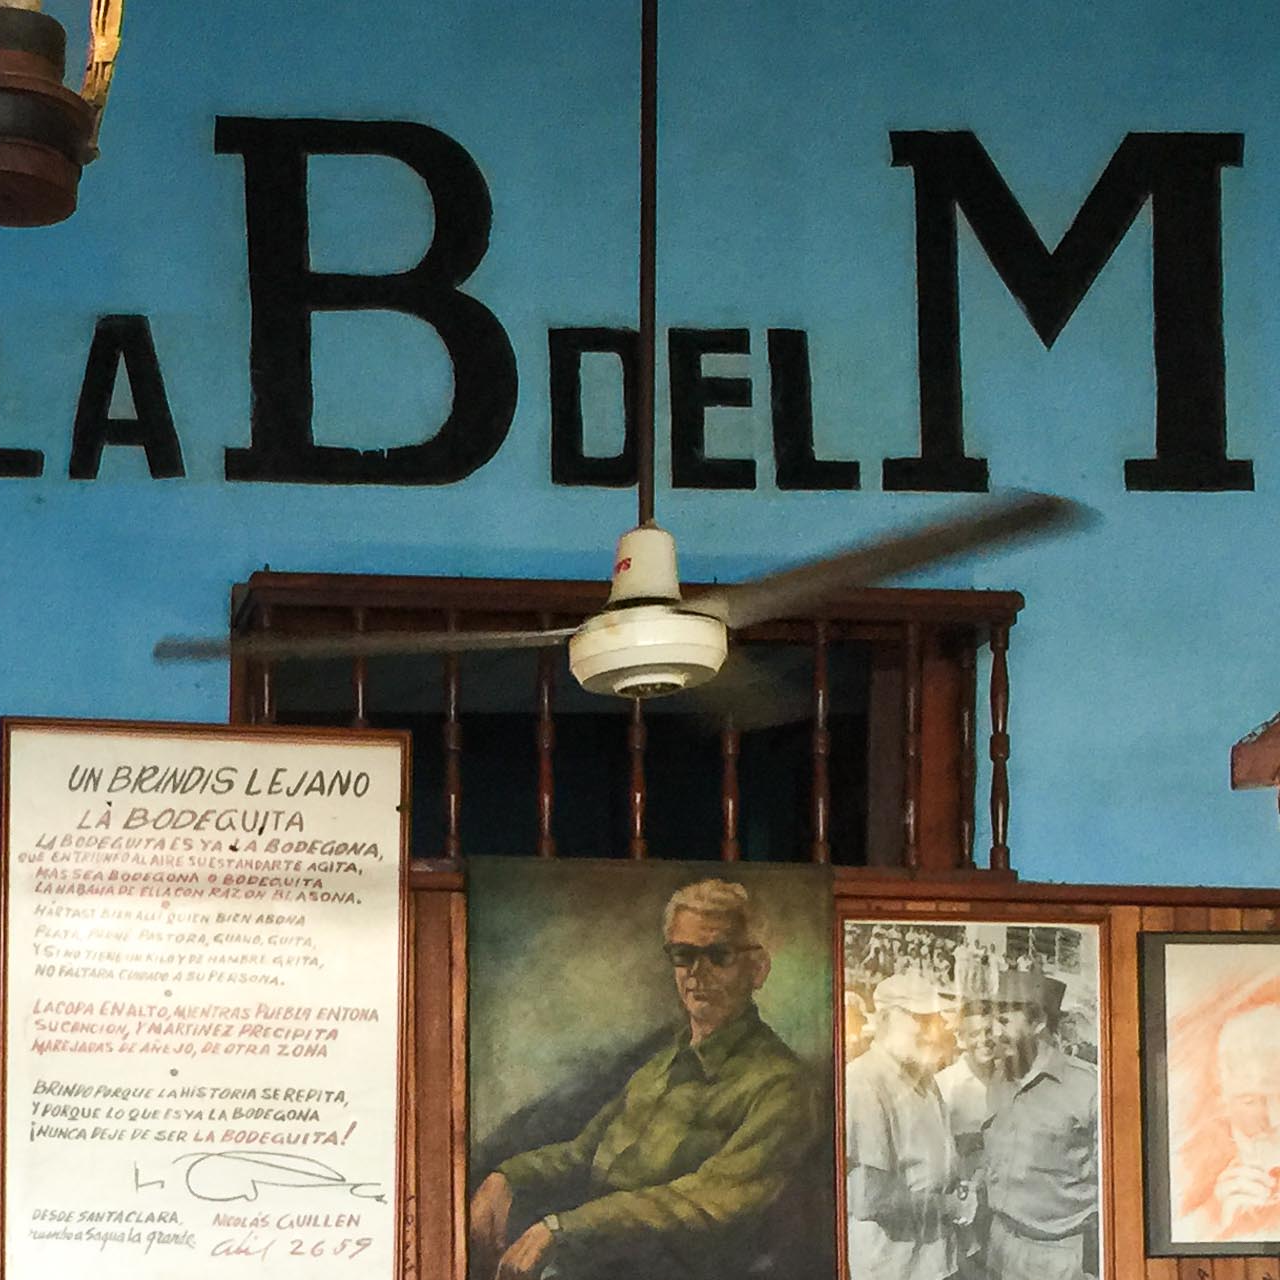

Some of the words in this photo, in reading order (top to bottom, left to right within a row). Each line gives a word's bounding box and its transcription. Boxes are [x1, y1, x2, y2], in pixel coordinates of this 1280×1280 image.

[213, 116, 518, 486] B
[548, 327, 861, 491] DEL
[881, 130, 1255, 491] M
[68, 764, 103, 792] UN
[107, 765, 238, 795] BRINDIS
[244, 767, 371, 797] LEJANO
[77, 809, 112, 830] LA
[122, 807, 305, 833] BODEGUITA
[60, 834, 166, 851] BODEGUITA
[200, 839, 222, 851] YA
[264, 838, 384, 861] BODEGONA,
[307, 860, 363, 876] AGITA,
[108, 869, 199, 884] BODEGONA
[222, 873, 323, 889] BODEGUITA
[239, 1023, 339, 1041] PRECIPITA
[224, 1043, 270, 1055] OTRA
[277, 1043, 328, 1058] ZONA
[41, 1104, 101, 1121] PORQUE
[106, 1107, 124, 1119] LO
[128, 1107, 161, 1121] QUE
[208, 1107, 228, 1121] LA
[232, 1106, 320, 1121] BODEGONA
[90, 1126, 126, 1141] DEJE
[131, 1128, 151, 1140] DE
[154, 1130, 187, 1142] SER
[193, 1130, 215, 1143] LA
[221, 1121, 357, 1146] BODEGUITA!
[32, 1208, 75, 1222] DESDE
[276, 1213, 361, 1230] GUILLEN
